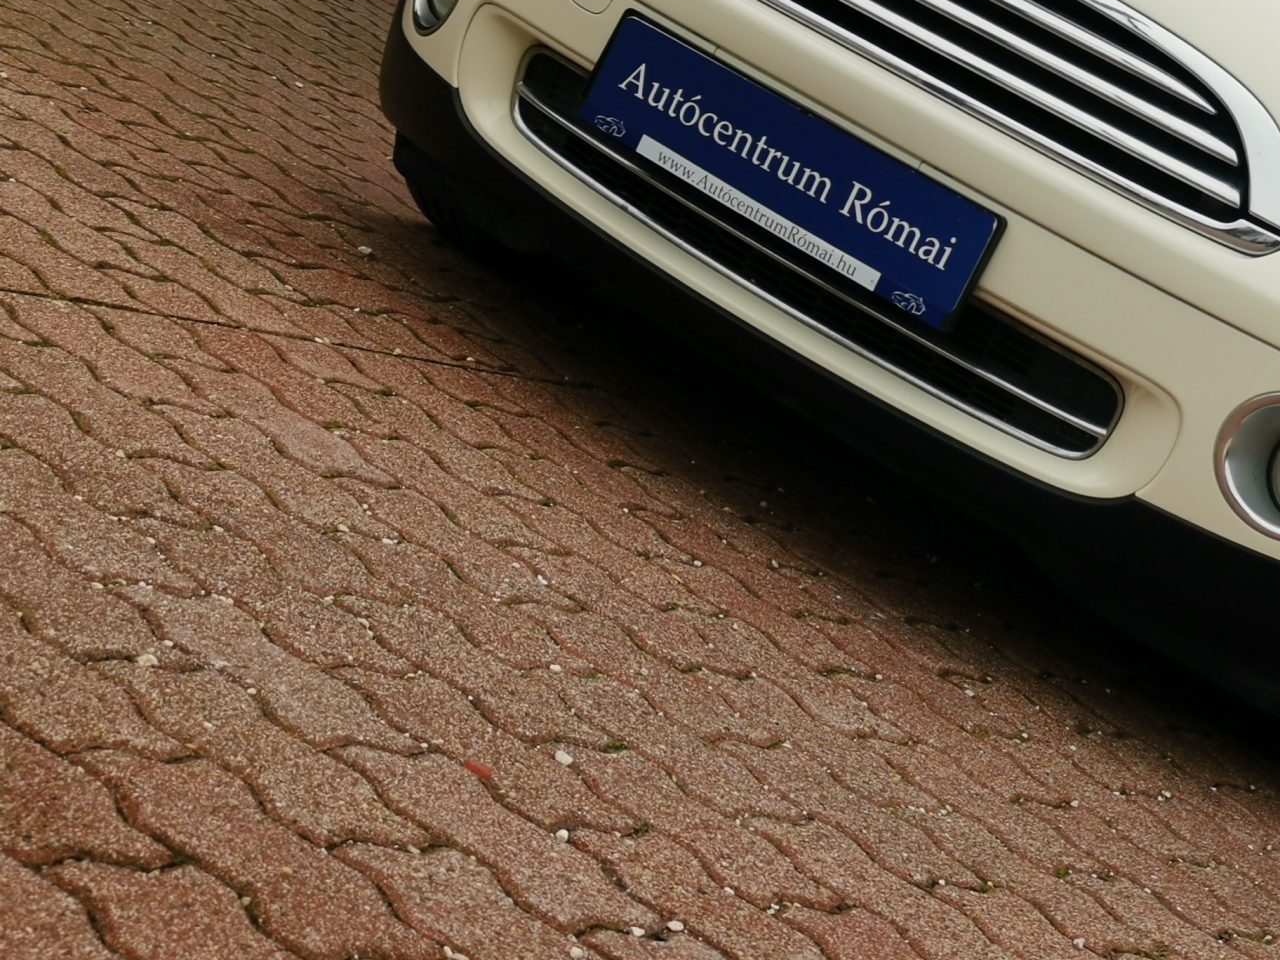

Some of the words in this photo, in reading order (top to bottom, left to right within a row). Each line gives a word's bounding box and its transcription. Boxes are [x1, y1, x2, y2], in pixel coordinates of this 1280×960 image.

[618, 62, 832, 205] Autócentrum
[838, 181, 958, 271] Római
[657, 150, 857, 278] www.AutócentrumRómai.hu
